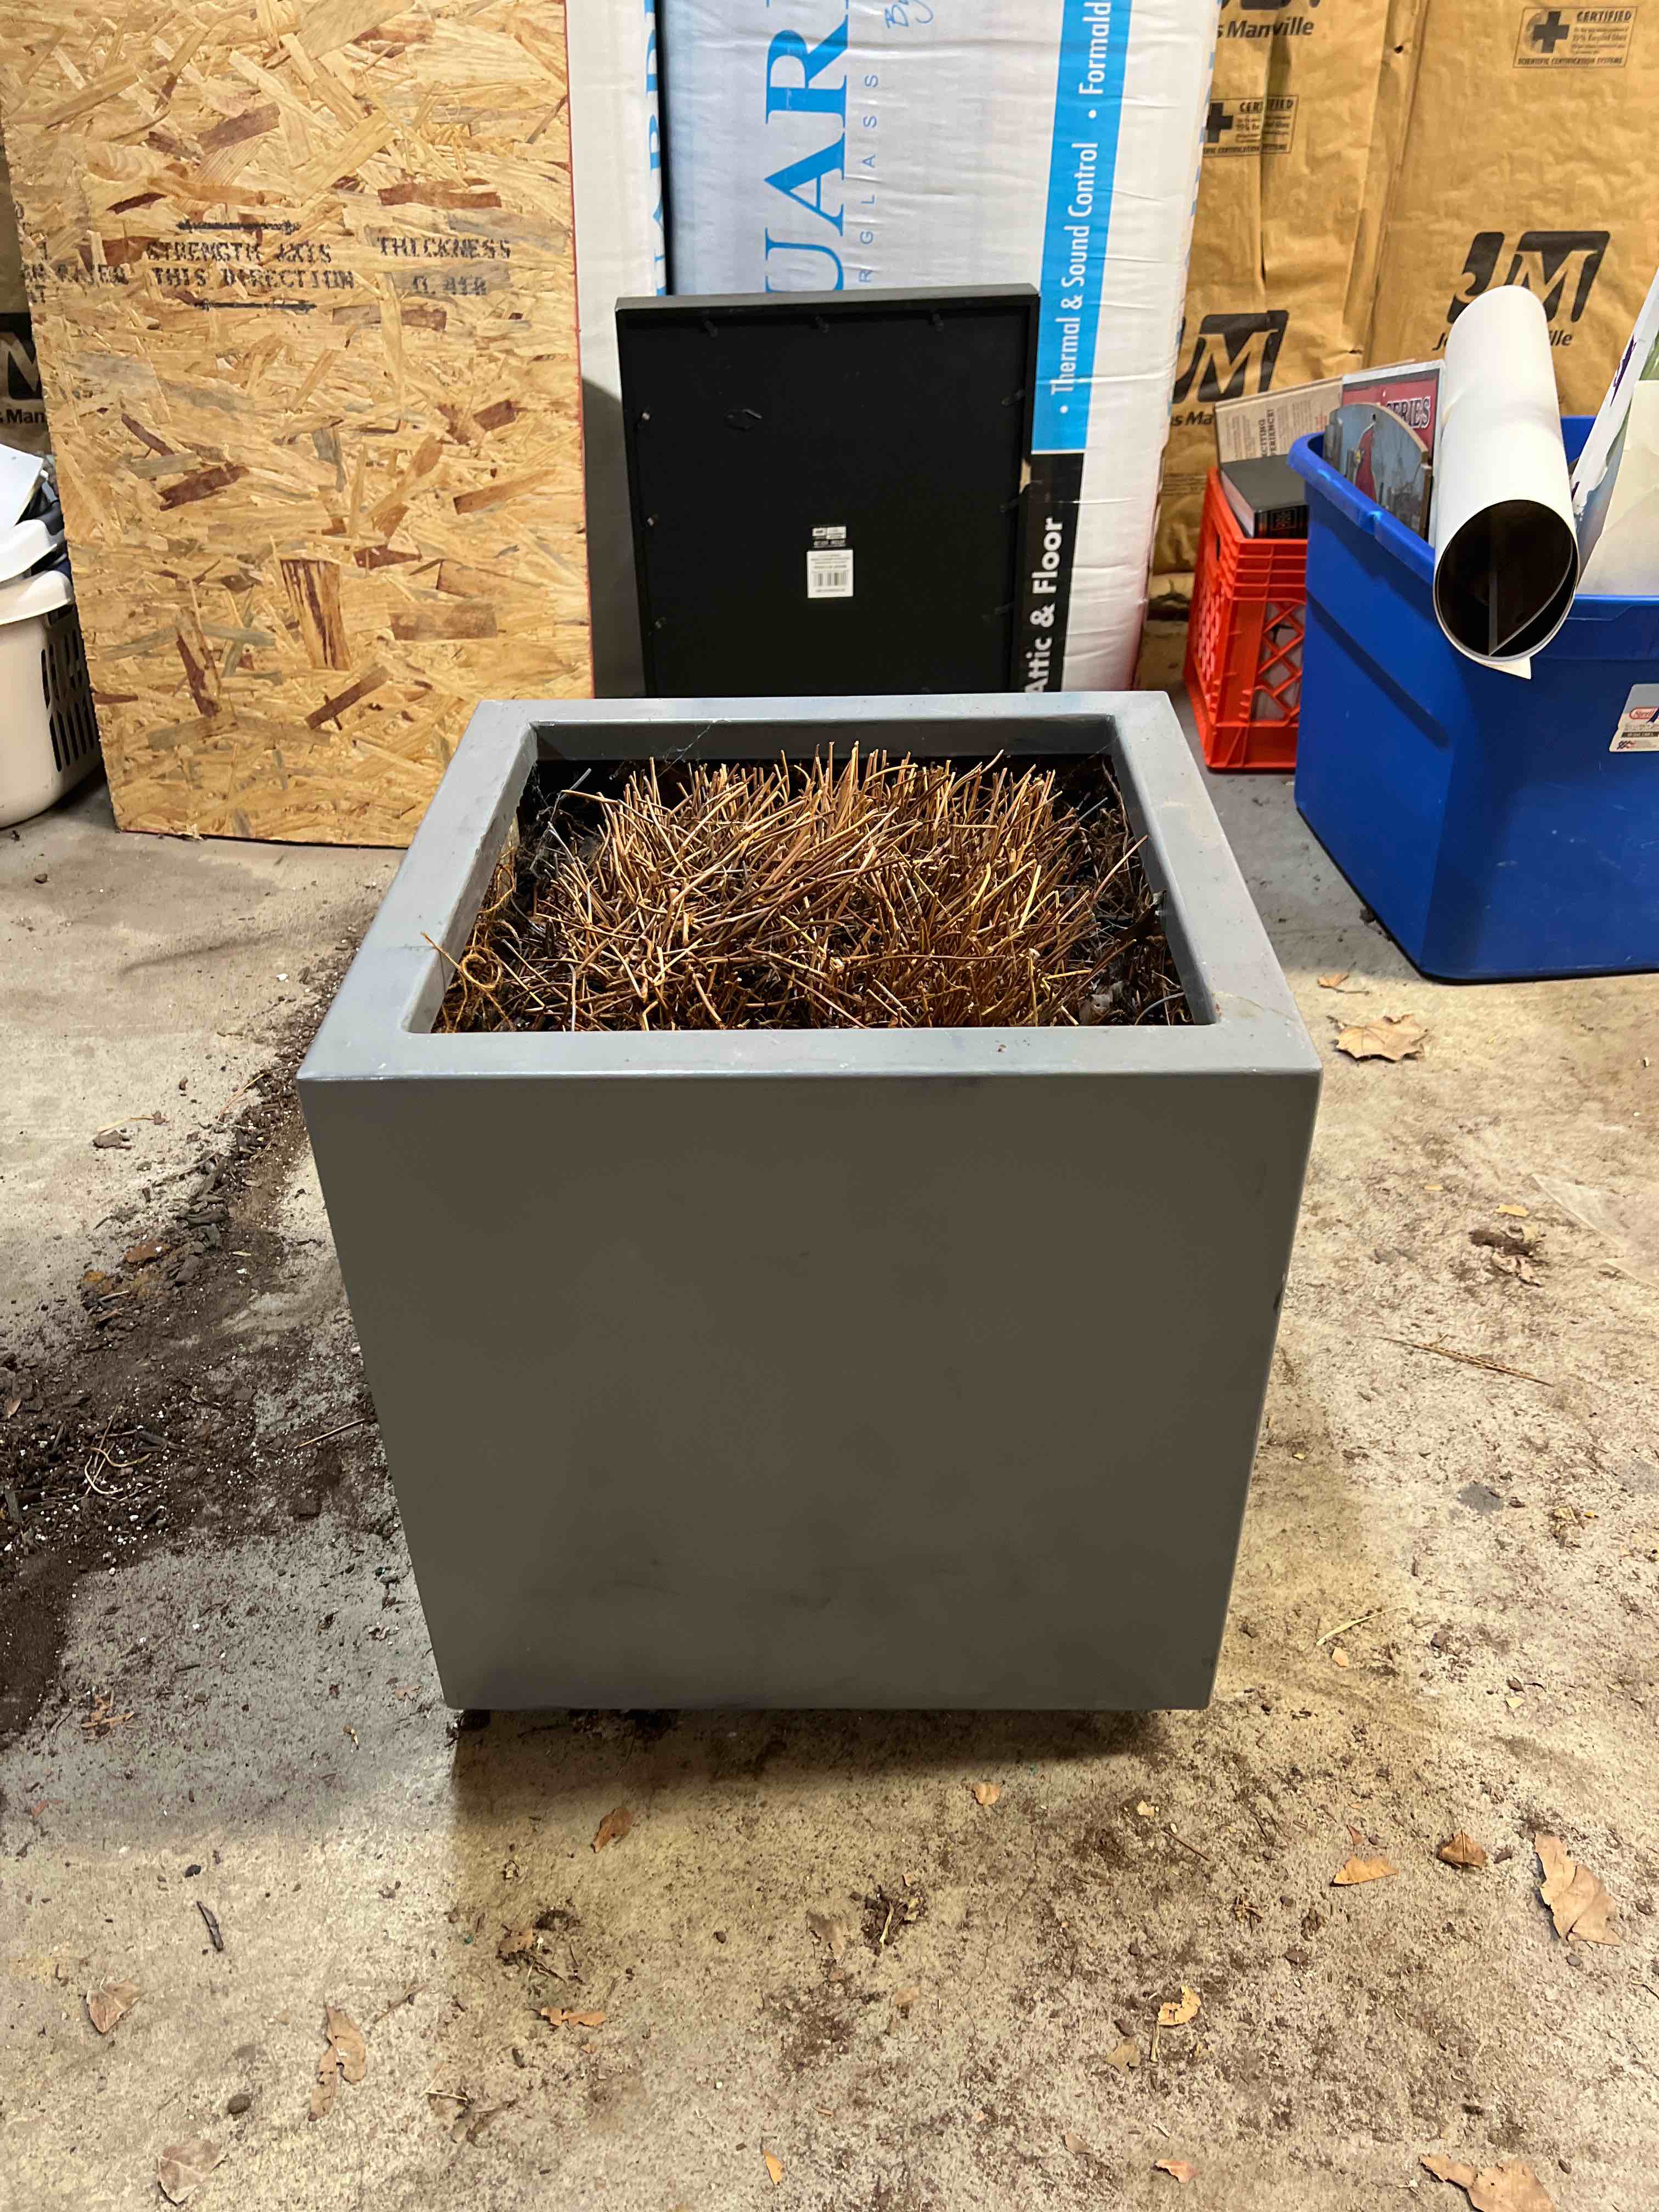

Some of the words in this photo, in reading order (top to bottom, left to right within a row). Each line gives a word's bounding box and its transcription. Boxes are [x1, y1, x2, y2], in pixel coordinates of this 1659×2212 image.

[1226, 16, 1314, 38] Manville
[1577, 10, 1633, 22] CERTIFIED
[1079, 1, 1111, 95] Formald
[764, 0, 848, 292] UAR
[1067, 143, 1099, 218] Control
[145, 241, 262, 261] STRENGTH
[377, 236, 511, 259] THICKNESS
[1061, 226, 1090, 287] Sound
[151, 267, 206, 286] THIS
[221, 267, 354, 289] DIRECTION
[1060, 295, 1083, 311] &
[1051, 317, 1081, 395] Thermal
[1031, 516, 1064, 595] Floor
[1030, 603, 1056, 628] &
[1024, 637, 1053, 693] Attic
